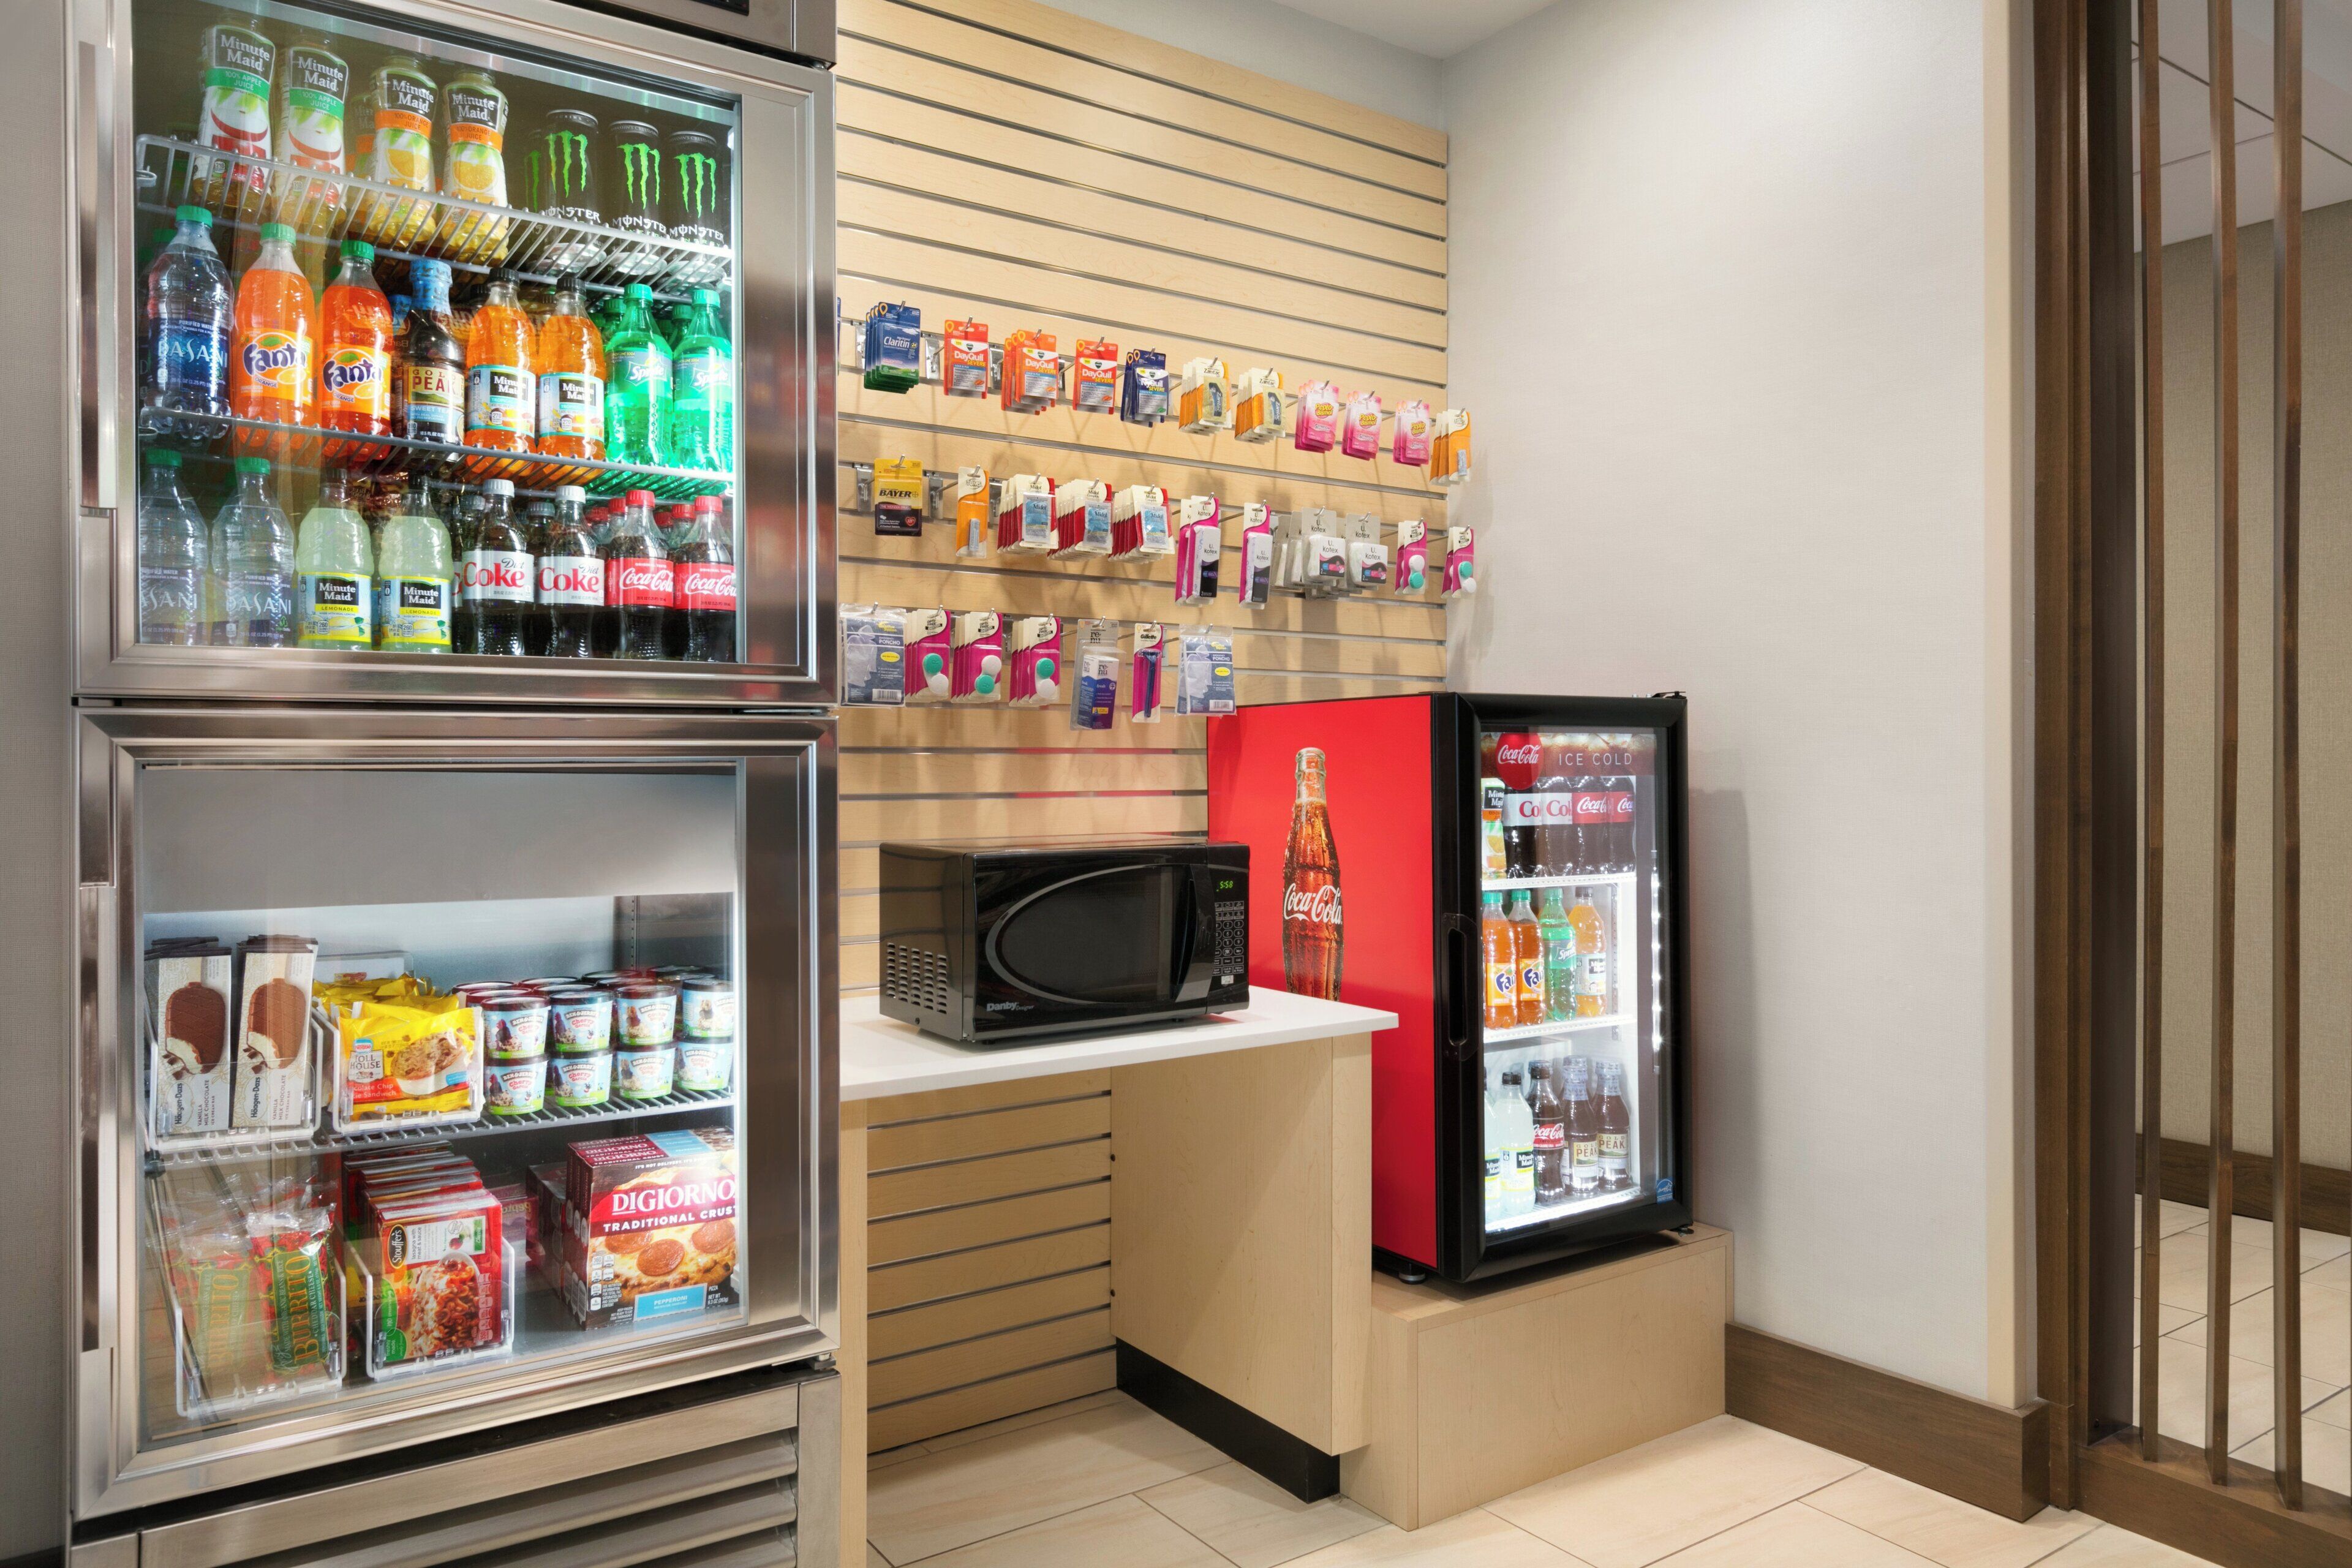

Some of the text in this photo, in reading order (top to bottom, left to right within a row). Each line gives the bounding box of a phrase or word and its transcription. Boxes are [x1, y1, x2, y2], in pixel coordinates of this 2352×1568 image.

[221, 34, 270, 61] Minute
[227, 49, 264, 72] Maid
[298, 56, 344, 81] Minute
[225, 71, 262, 87] 100% APPLE
[234, 80, 254, 91] JUICE
[304, 70, 338, 92] Maid
[392, 79, 434, 103] Minute
[310, 100, 330, 110] JUICE
[318, 94, 337, 107] APPLE
[398, 93, 429, 113] Maid
[452, 94, 495, 111] Minute
[407, 114, 429, 128] ORANGE
[458, 105, 489, 121] Maid
[404, 121, 421, 130] JUICE
[468, 126, 491, 136] ORANGE
[612, 215, 667, 235] MONSTER
[670, 224, 725, 244] MONSTER
[883, 336, 910, 349] Claritin
[158, 338, 228, 368] DASANI
[243, 342, 306, 376] Fanta
[954, 350, 984, 361] DayQuil
[1025, 358, 1055, 369] DayQuil
[323, 358, 383, 392] Fanta
[630, 366, 665, 381] Sprite
[693, 371, 728, 386] Sprite
[1082, 369, 1112, 379] DayQuil
[254, 376, 279, 388] ORANGE
[1259, 378, 1275, 386] Zantac
[333, 392, 355, 403] ORANGE
[966, 479, 982, 488] TUMS
[463, 561, 525, 587] Coke
[538, 567, 600, 593] Coke
[319, 582, 356, 593] Minute
[404, 587, 439, 597] Minute
[226, 592, 291, 616] DASANI
[324, 591, 353, 601] Maid
[409, 595, 436, 605] Maid
[1498, 744, 1632, 766] Coca-Cola ICE COLD
[1284, 883, 1343, 925] Coca-Cola
[1496, 973, 1516, 993] Fan
[1524, 968, 1544, 988] Fan
[987, 1001, 1017, 1011] Danby
[350, 1061, 382, 1070] HOUSE
[355, 1054, 375, 1063] TOLL
[175, 1082, 185, 1125] Häagen-Dazs
[251, 1076, 261, 1118] Häagen-Dazs
[578, 1135, 639, 1147] DIGIORNO
[586, 1143, 648, 1155] DIGIORNO
[1599, 1140, 1626, 1149] PEAK
[586, 1149, 632, 1158] TRADITIONAL
[593, 1150, 657, 1162] DIGIORNO
[612, 1178, 735, 1213] DIGIORNO
[603, 1212, 695, 1232] TRADITIONAL
[392, 1229, 404, 1264] Stouffer's
[277, 1277, 286, 1295] BEANS
[279, 1296, 288, 1321] ORGANIC
[654, 1295, 688, 1306] PEPPERONI
[285, 1255, 320, 1364] BURRITO
[311, 1300, 319, 1334] CHEDDAR
[206, 1274, 239, 1368] BURRITO
[387, 1317, 393, 1328] no
